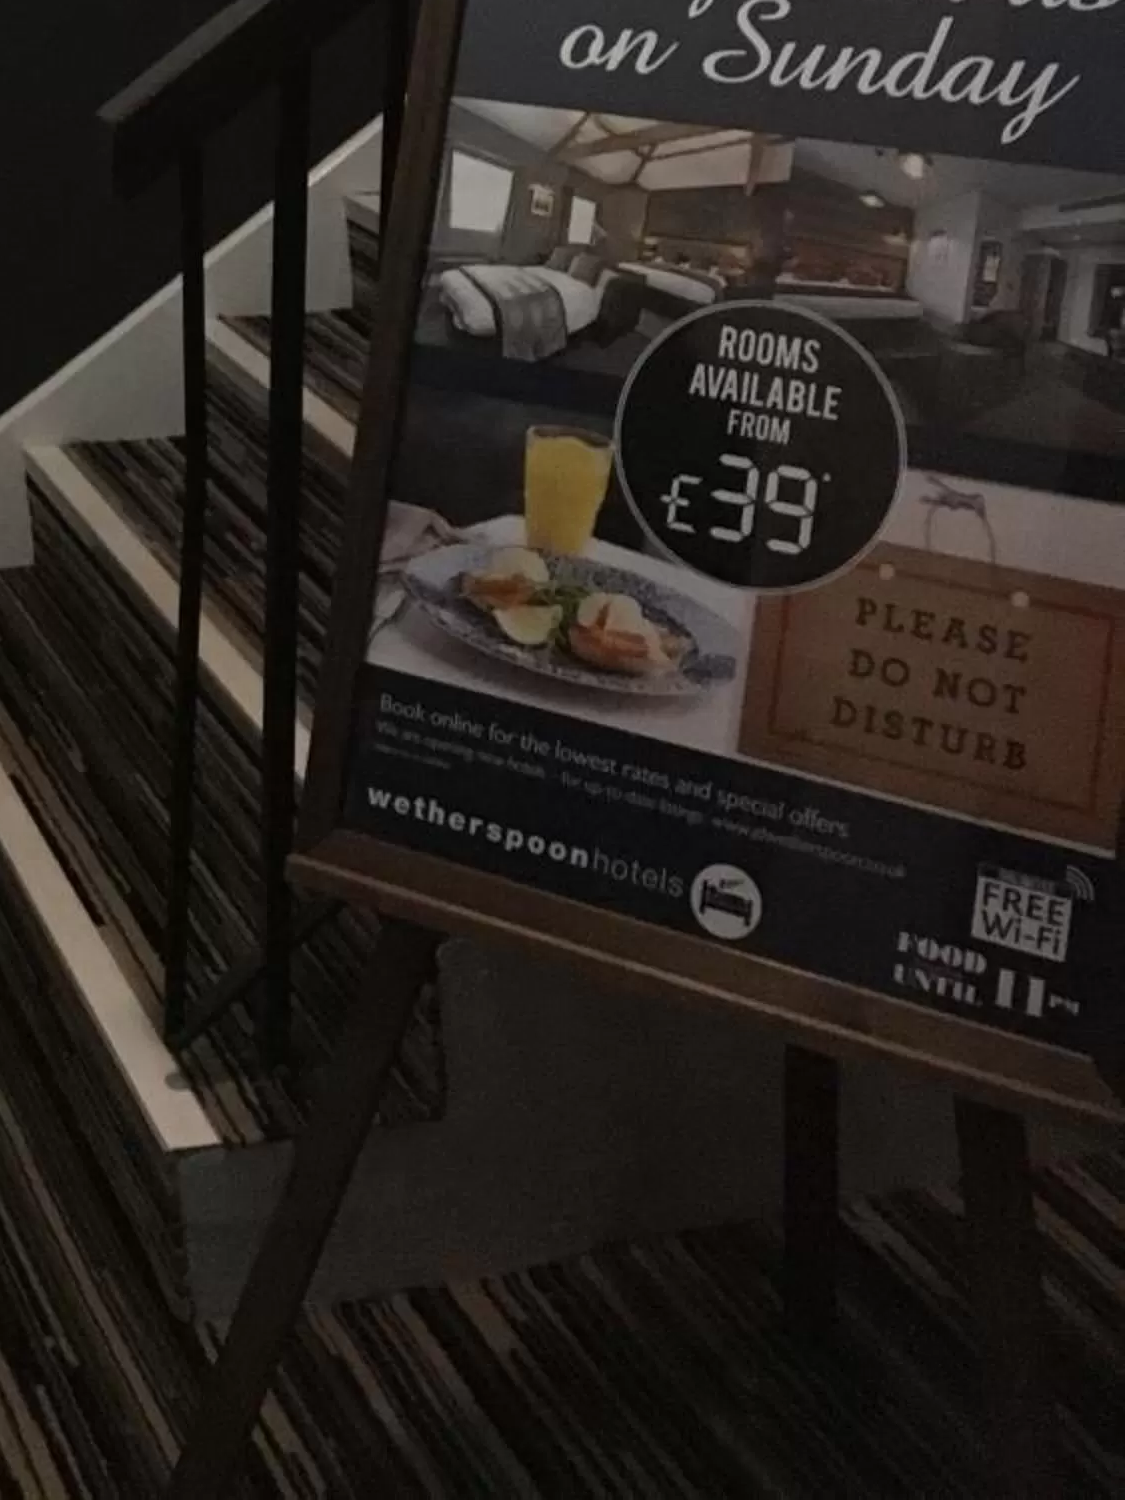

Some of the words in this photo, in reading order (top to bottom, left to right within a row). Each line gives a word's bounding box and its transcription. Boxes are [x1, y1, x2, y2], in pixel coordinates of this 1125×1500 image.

[559, 23, 680, 75] on
[717, 323, 823, 374] ROOMS
[688, 362, 843, 421] AVAILABLE
[726, 408, 792, 446] FROM
[855, 597, 1032, 664] PLEASE
[848, 648, 910, 687] DO
[932, 667, 1028, 715] NOT
[830, 695, 1028, 770] DISTURB
[379, 692, 426, 723] Book
[429, 711, 486, 740] online
[486, 722, 518, 746] for
[519, 732, 551, 757] the
[553, 739, 618, 777] lowest
[621, 761, 671, 791] rates
[674, 779, 712, 801] and
[716, 787, 786, 822] special
[787, 804, 851, 839] offers
[982, 881, 1066, 927] FREE
[896, 931, 988, 975] FOOD
[981, 909, 1063, 955] Wi-Fi
